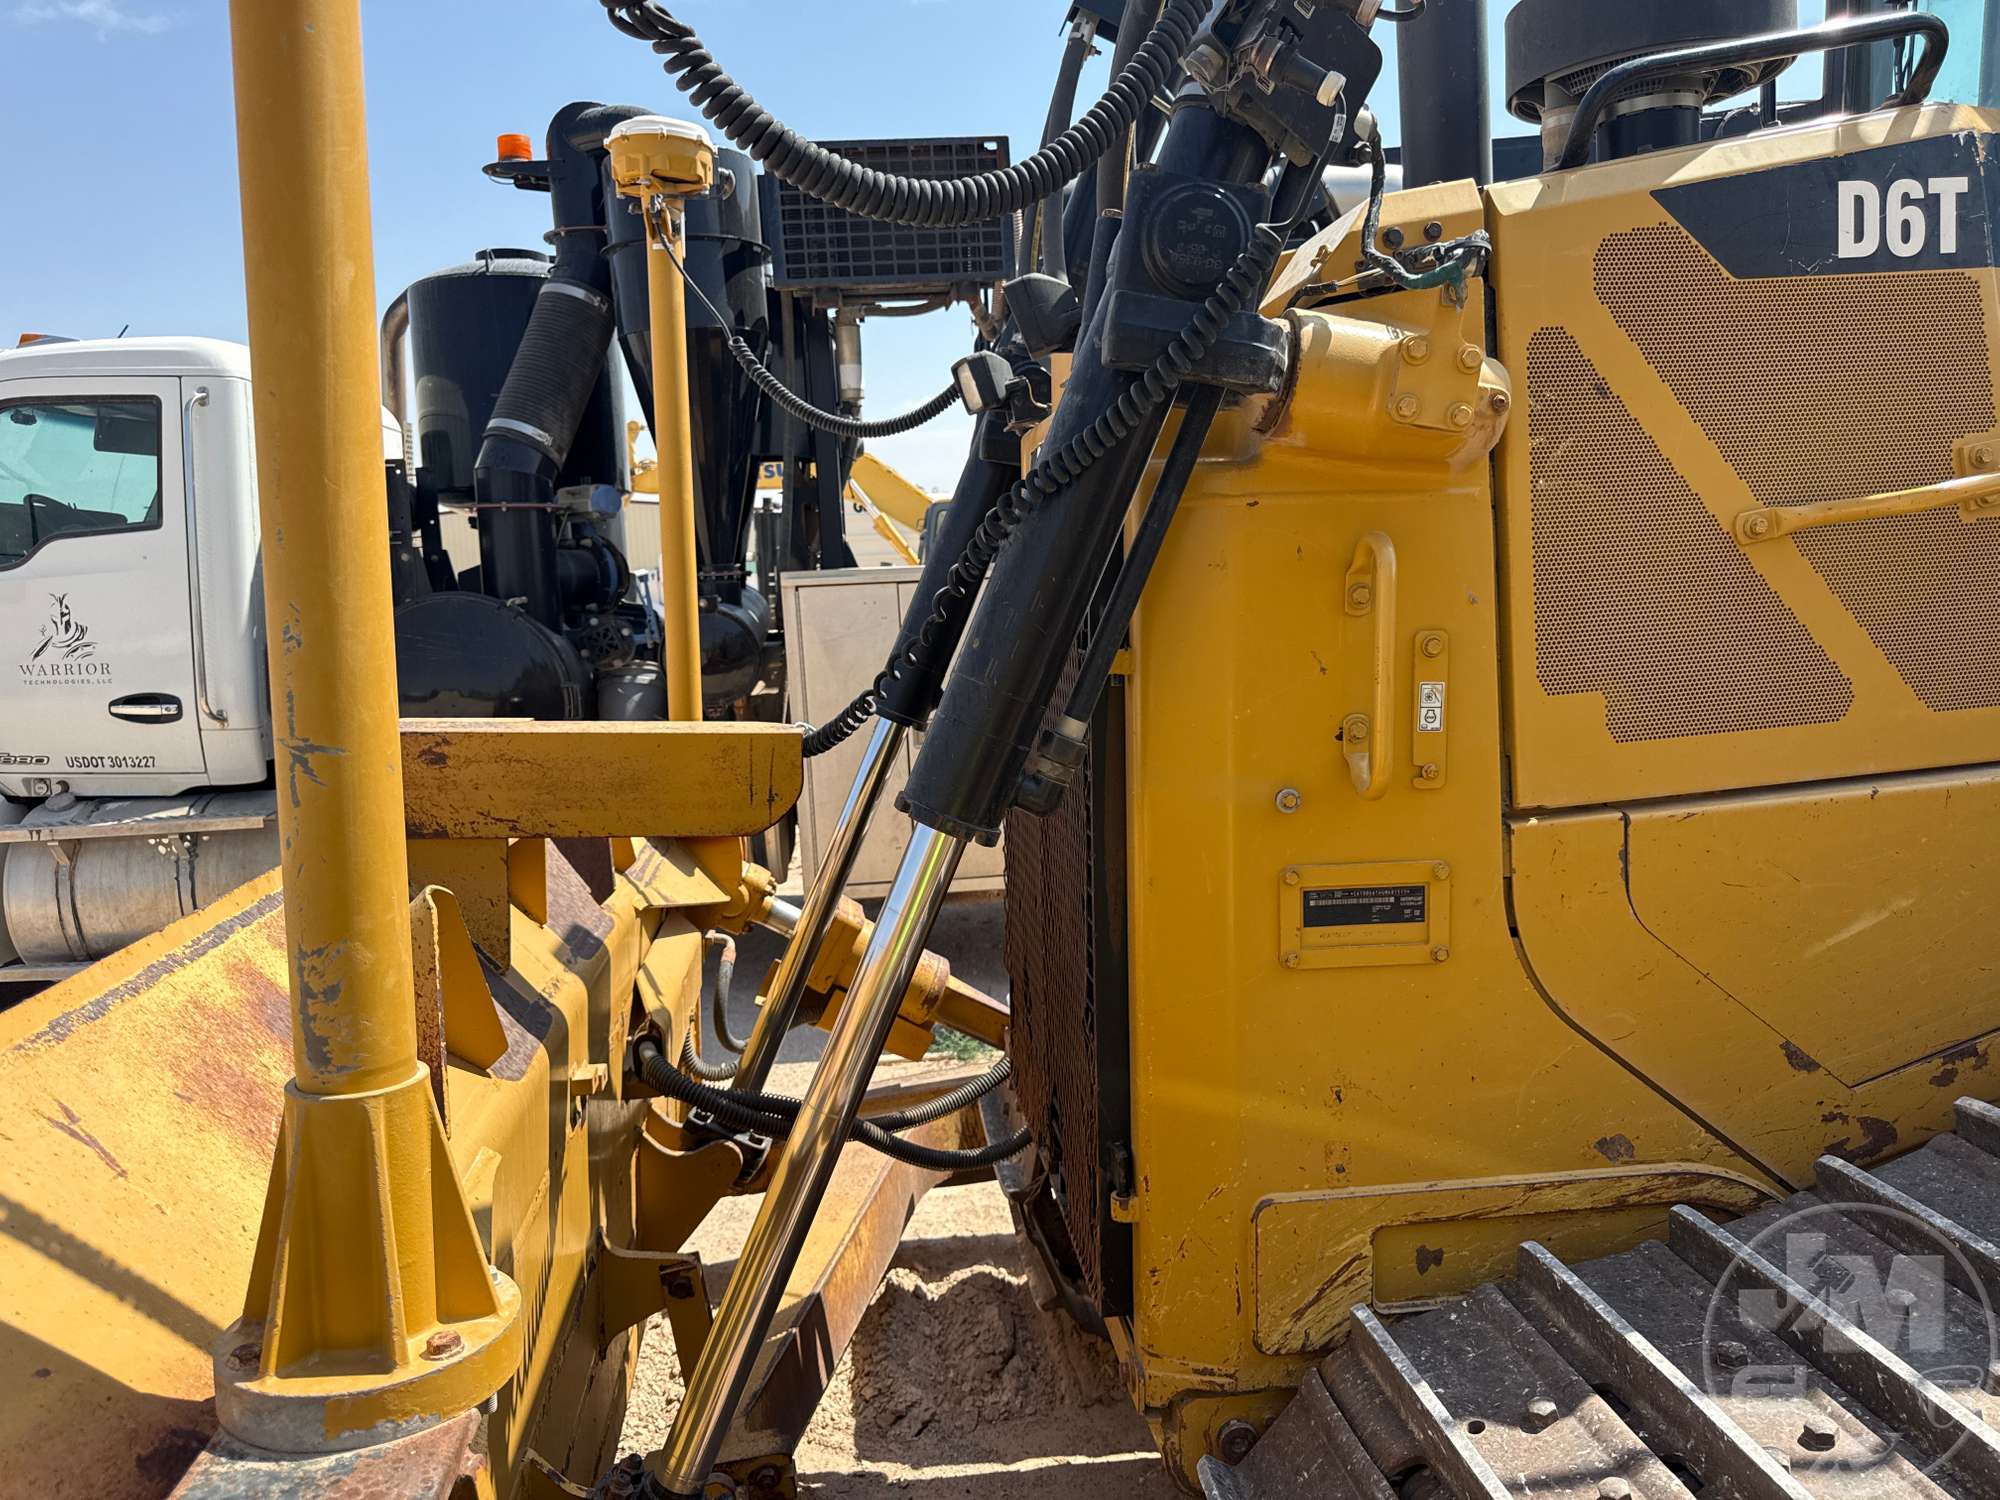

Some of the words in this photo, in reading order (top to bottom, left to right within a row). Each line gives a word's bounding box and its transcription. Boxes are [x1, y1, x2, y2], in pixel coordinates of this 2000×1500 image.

[1838, 176, 1969, 259] D6T
[18, 662, 112, 676] WARRIOR
[65, 755, 105, 768] USDOT
[107, 755, 156, 768] 3013227
